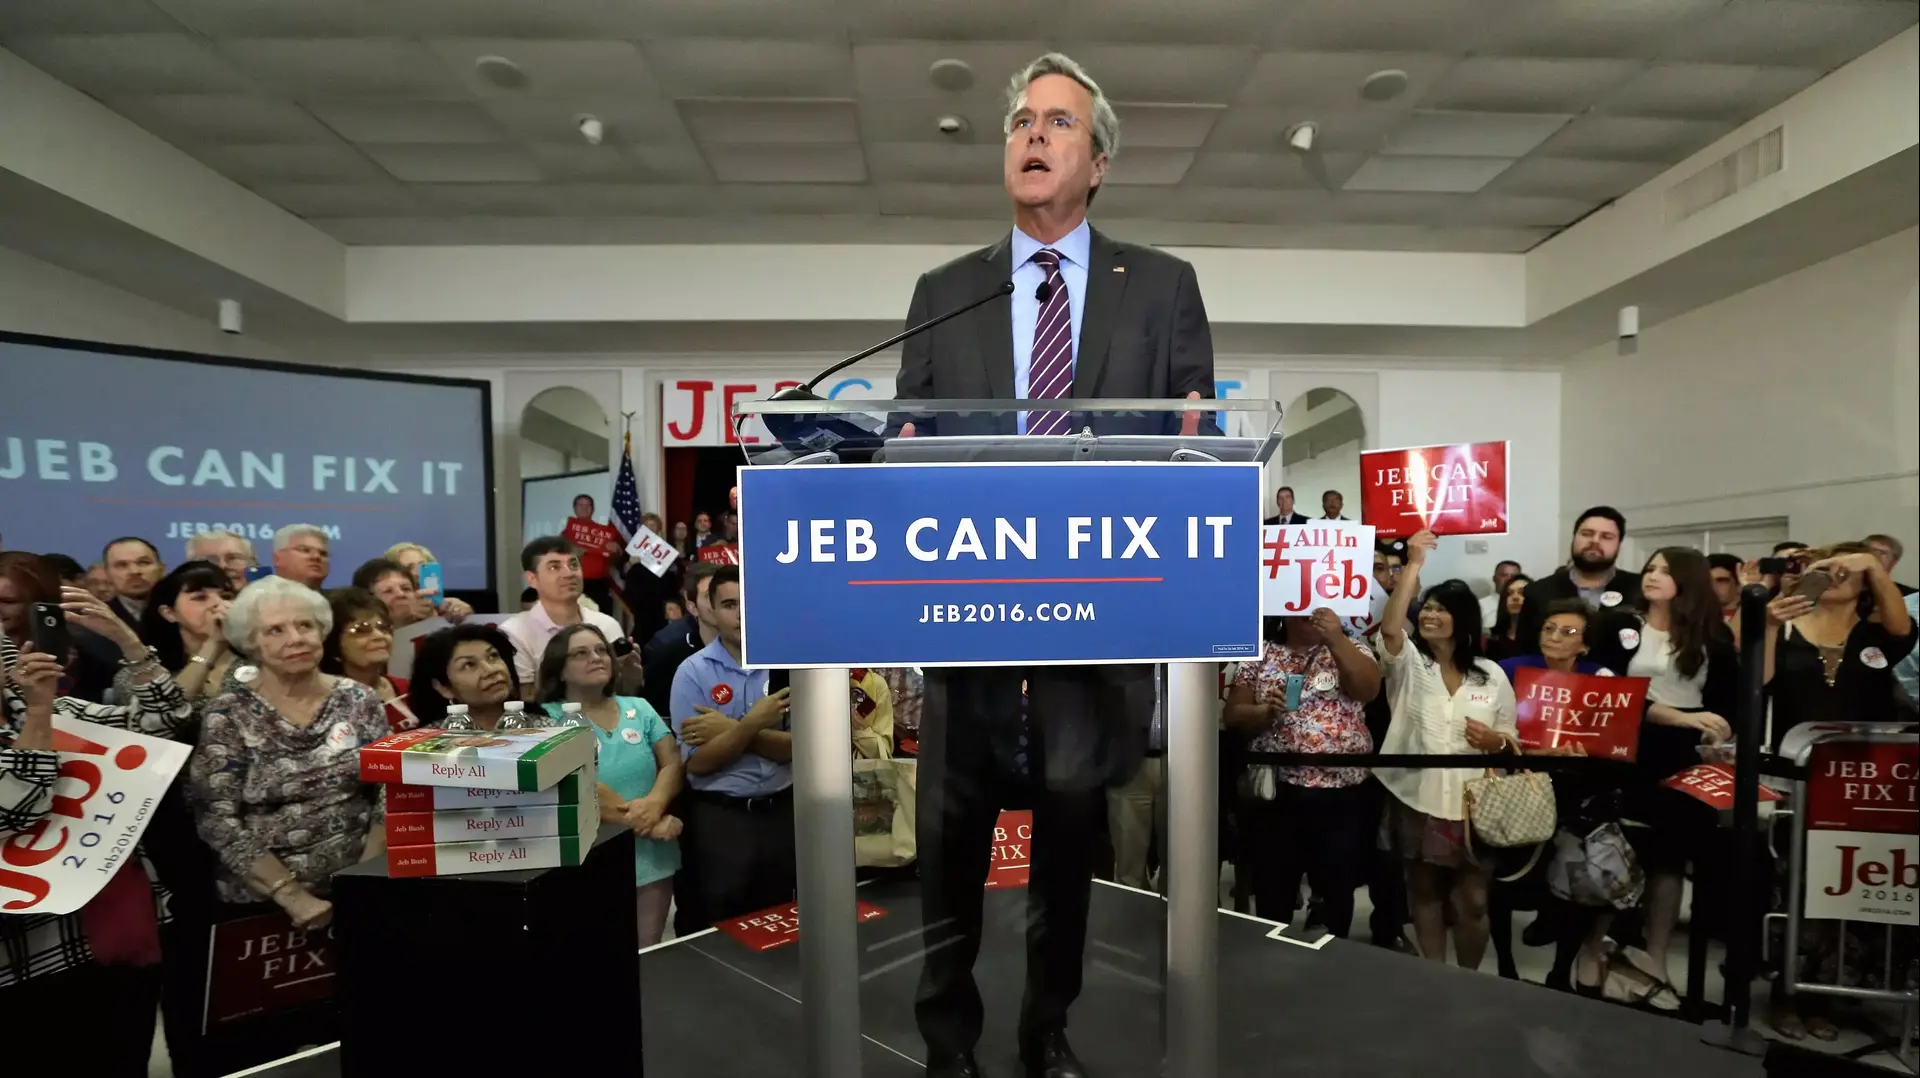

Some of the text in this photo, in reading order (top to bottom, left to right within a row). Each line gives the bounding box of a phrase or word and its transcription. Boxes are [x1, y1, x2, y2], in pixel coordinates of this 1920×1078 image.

[0, 437, 463, 495] JEB CAN FIX IT
[1431, 461, 1489, 481] CAN
[1449, 485, 1473, 502] IT
[775, 515, 1233, 564] JEB CAN FIX IT
[1293, 528, 1329, 547] All
[1335, 529, 1357, 547] In
[1321, 549, 1336, 571] 4
[1284, 559, 1368, 612] Jeb
[919, 602, 1096, 624] JEB2016.COM
[1527, 684, 1633, 708] JEB CAN
[1540, 706, 1614, 727] FIX IT
[431, 763, 465, 779] Reply
[468, 765, 486, 777] All
[1825, 760, 1879, 779] JEB
[467, 787, 502, 801] Reply
[1681, 776, 1733, 797] JEB
[1843, 783, 1895, 802] FIX
[62, 791, 125, 869] 2016
[408, 824, 425, 832] Bush
[466, 818, 502, 831] Reply
[506, 816, 525, 827] All
[97, 797, 154, 875] Jeb2016.com
[410, 857, 428, 865] Bush
[469, 850, 504, 864] Reply
[508, 848, 527, 859] All
[1861, 889, 1915, 902] 2016
[738, 913, 783, 931] JEB
[263, 947, 326, 980] FIX
